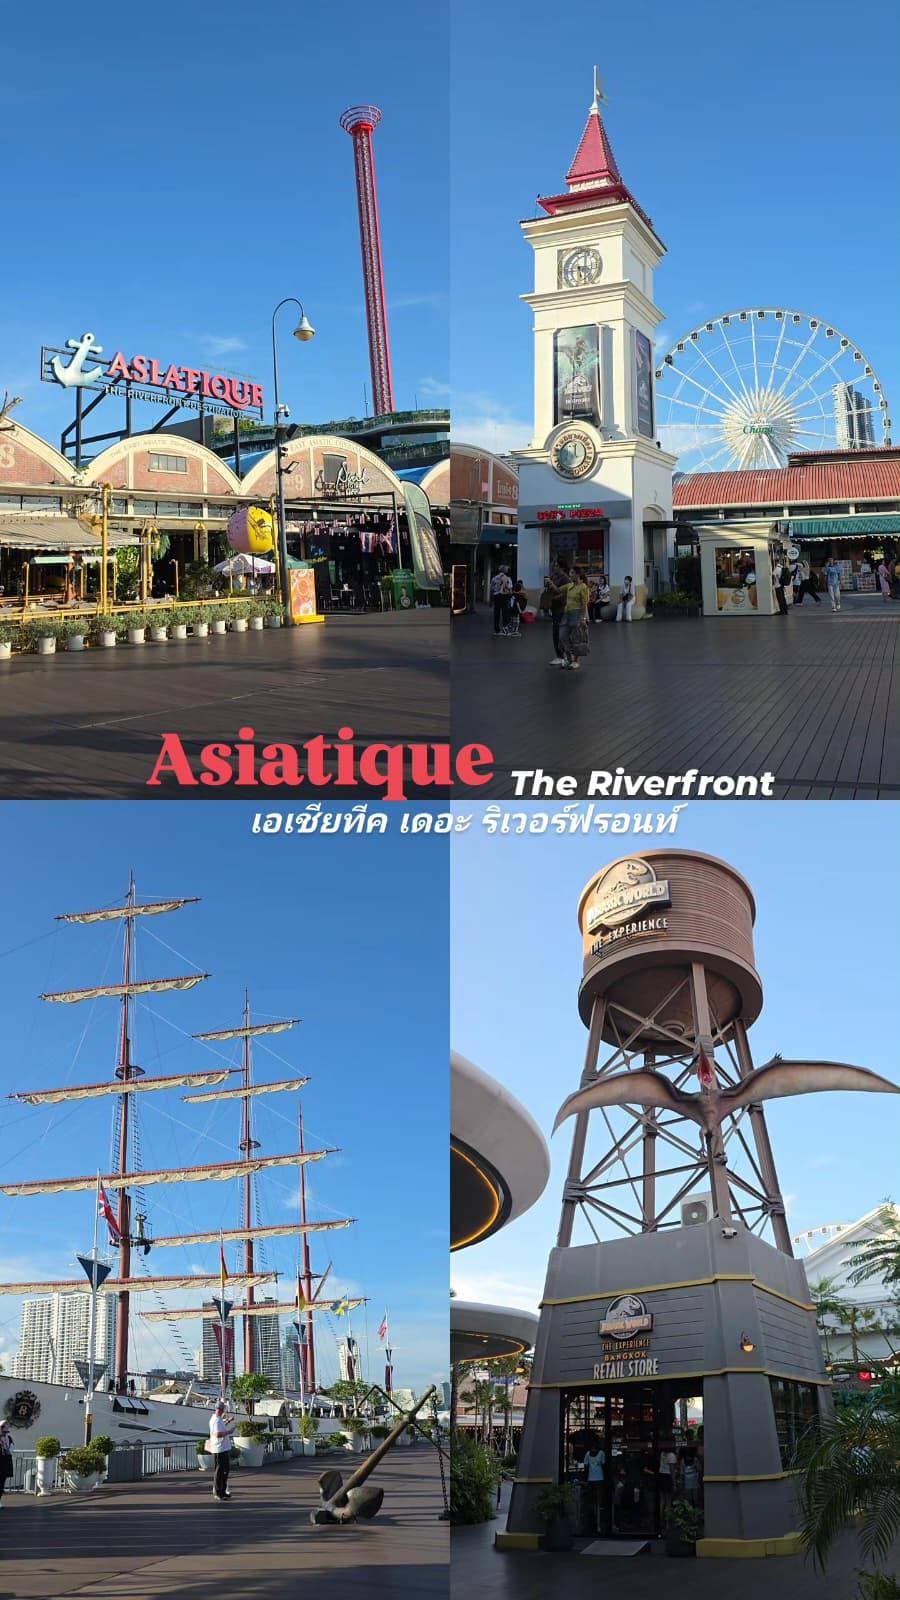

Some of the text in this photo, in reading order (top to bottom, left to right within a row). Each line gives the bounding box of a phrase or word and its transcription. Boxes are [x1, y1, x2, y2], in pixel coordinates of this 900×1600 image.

[104, 351, 265, 410] ASIATIQUE
[105, 385, 124, 398] THE
[127, 389, 188, 409] RIVERFRONT
[622, 884, 666, 905] WORLD
[608, 918, 670, 941] EXPERIENCE
[602, 1339, 649, 1351] THE EXPERIENCE
[604, 1350, 647, 1361] BANGKOK
[593, 1358, 659, 1380] RETAIL STORE
